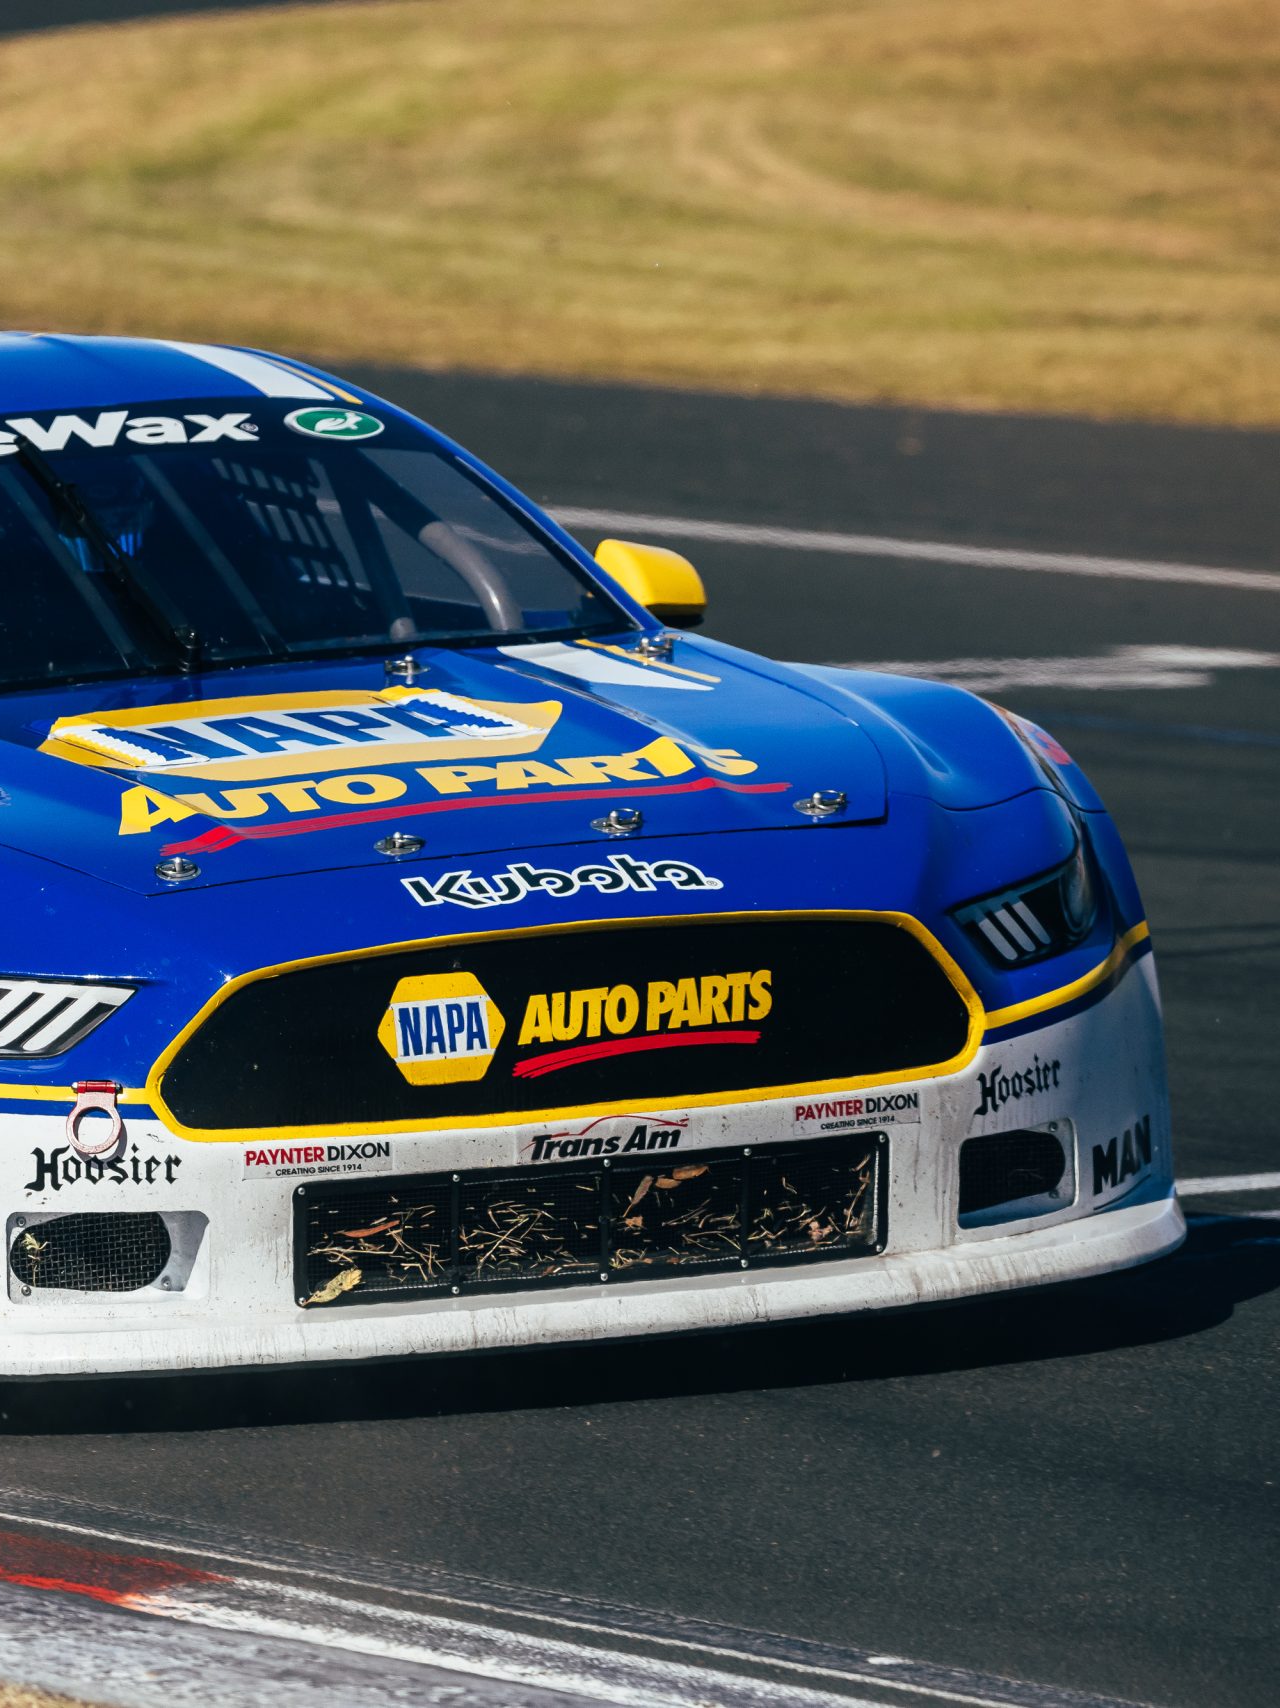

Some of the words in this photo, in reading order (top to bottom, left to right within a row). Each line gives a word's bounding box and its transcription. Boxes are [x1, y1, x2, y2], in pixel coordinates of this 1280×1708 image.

[91, 698, 514, 762] NAPA
[120, 773, 407, 836] AUTO
[416, 736, 758, 794] PARTS
[401, 854, 716, 909] Kubota
[398, 1001, 488, 1057] NAPA
[517, 983, 639, 1046] AUTO
[647, 969, 772, 1032] PARTS
[795, 1099, 863, 1121] PAYNTER
[865, 1093, 918, 1113] DIXON
[974, 1053, 1061, 1116] Hoosier
[821, 1120, 855, 1130] CREATING
[857, 1117, 877, 1126] SINCE
[879, 1115, 895, 1124] 1914
[24, 1143, 182, 1192] Hoosier
[245, 1146, 325, 1167] PAYNTER
[327, 1142, 390, 1161] DIXON
[275, 1166, 316, 1177] CREATING
[317, 1165, 340, 1174] SINCE
[343, 1163, 362, 1172] 1914
[1092, 1115, 1151, 1196] MAN
